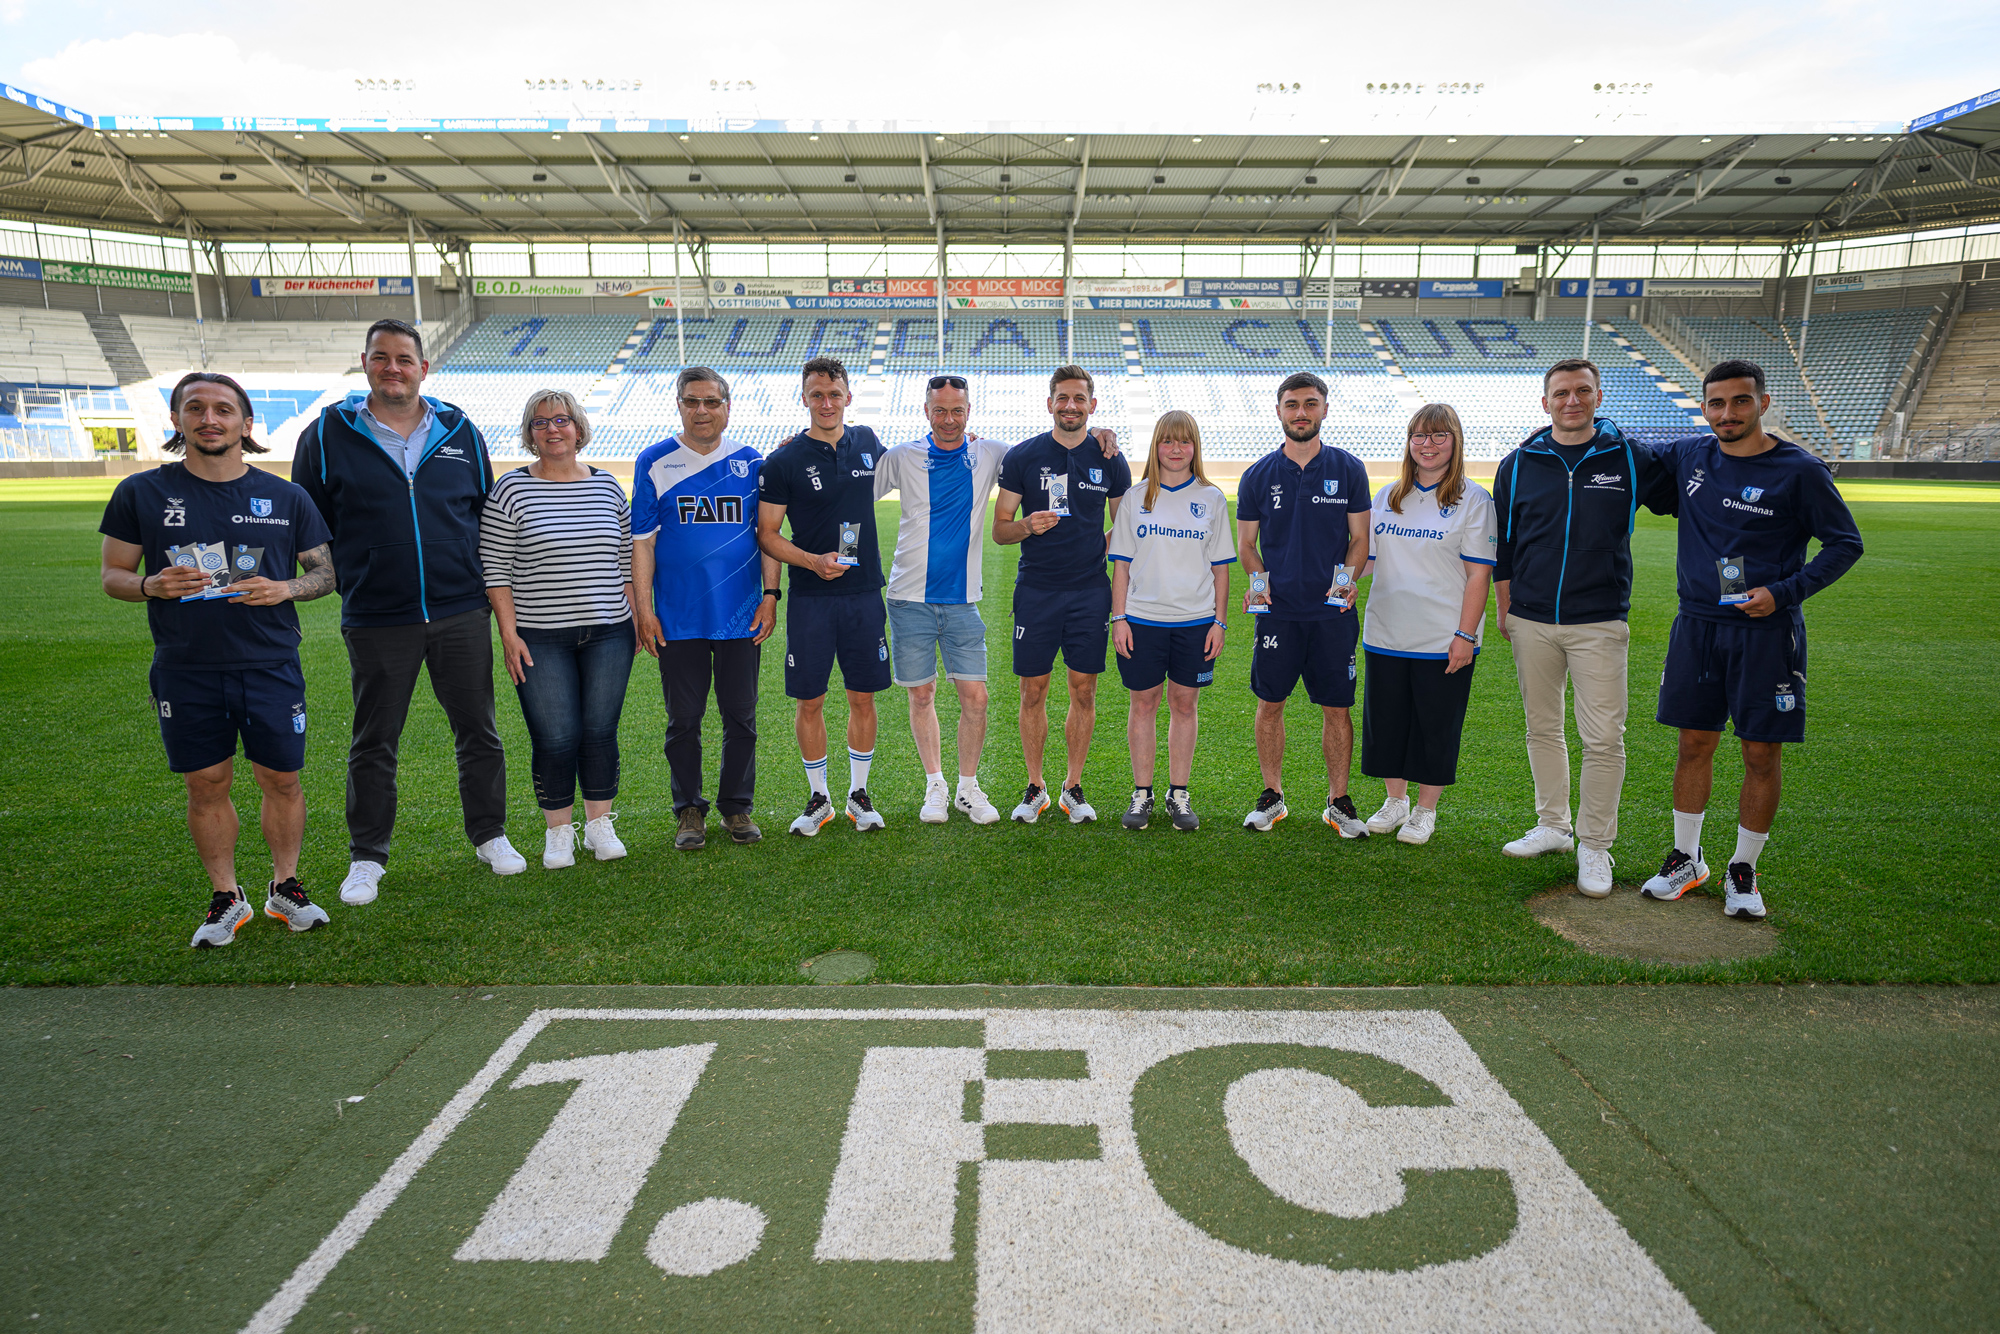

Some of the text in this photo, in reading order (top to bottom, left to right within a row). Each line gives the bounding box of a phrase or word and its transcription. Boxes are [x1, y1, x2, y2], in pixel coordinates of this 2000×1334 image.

[88, 268, 147, 283] SEGUIN
[1830, 275, 1863, 285] WEIGEL
[284, 281, 305, 290] Der
[308, 278, 375, 290] Küchenchef
[596, 281, 632, 292] NEMO
[832, 281, 855, 293] ets
[862, 281, 885, 293] ets
[889, 281, 927, 293] MDCC
[977, 280, 1016, 292] MDCC
[1021, 280, 1061, 292] MDCC
[1094, 286, 1163, 294] www.wg1893.de
[1223, 281, 1260, 291] KÖNNEN
[1432, 282, 1479, 292] Pergande
[718, 297, 782, 308] OSTTRIBÜNE
[795, 299, 818, 308] GUT
[820, 299, 841, 308] UND
[1021, 300, 1085, 308] OSTTRIBNE
[1099, 299, 1212, 309] HIER BIN ICH ZUHAUSE
[1295, 299, 1358, 308] OSTTRBÜNE
[812, 476, 823, 491] 9
[1686, 480, 1701, 497] 77
[1272, 496, 1282, 509] 2
[1731, 500, 1774, 516] Humanas
[676, 495, 743, 524] FAM
[164, 509, 186, 527] 23
[244, 515, 290, 526] Humanas
[1149, 523, 1205, 541] Humanas
[1386, 523, 1444, 541] Humanas
[1015, 626, 1025, 640] 17
[1262, 635, 1278, 649] 34
[788, 653, 795, 667] 9
[271, 900, 297, 921] BROOKS
[224, 904, 245, 933] BROOKS
